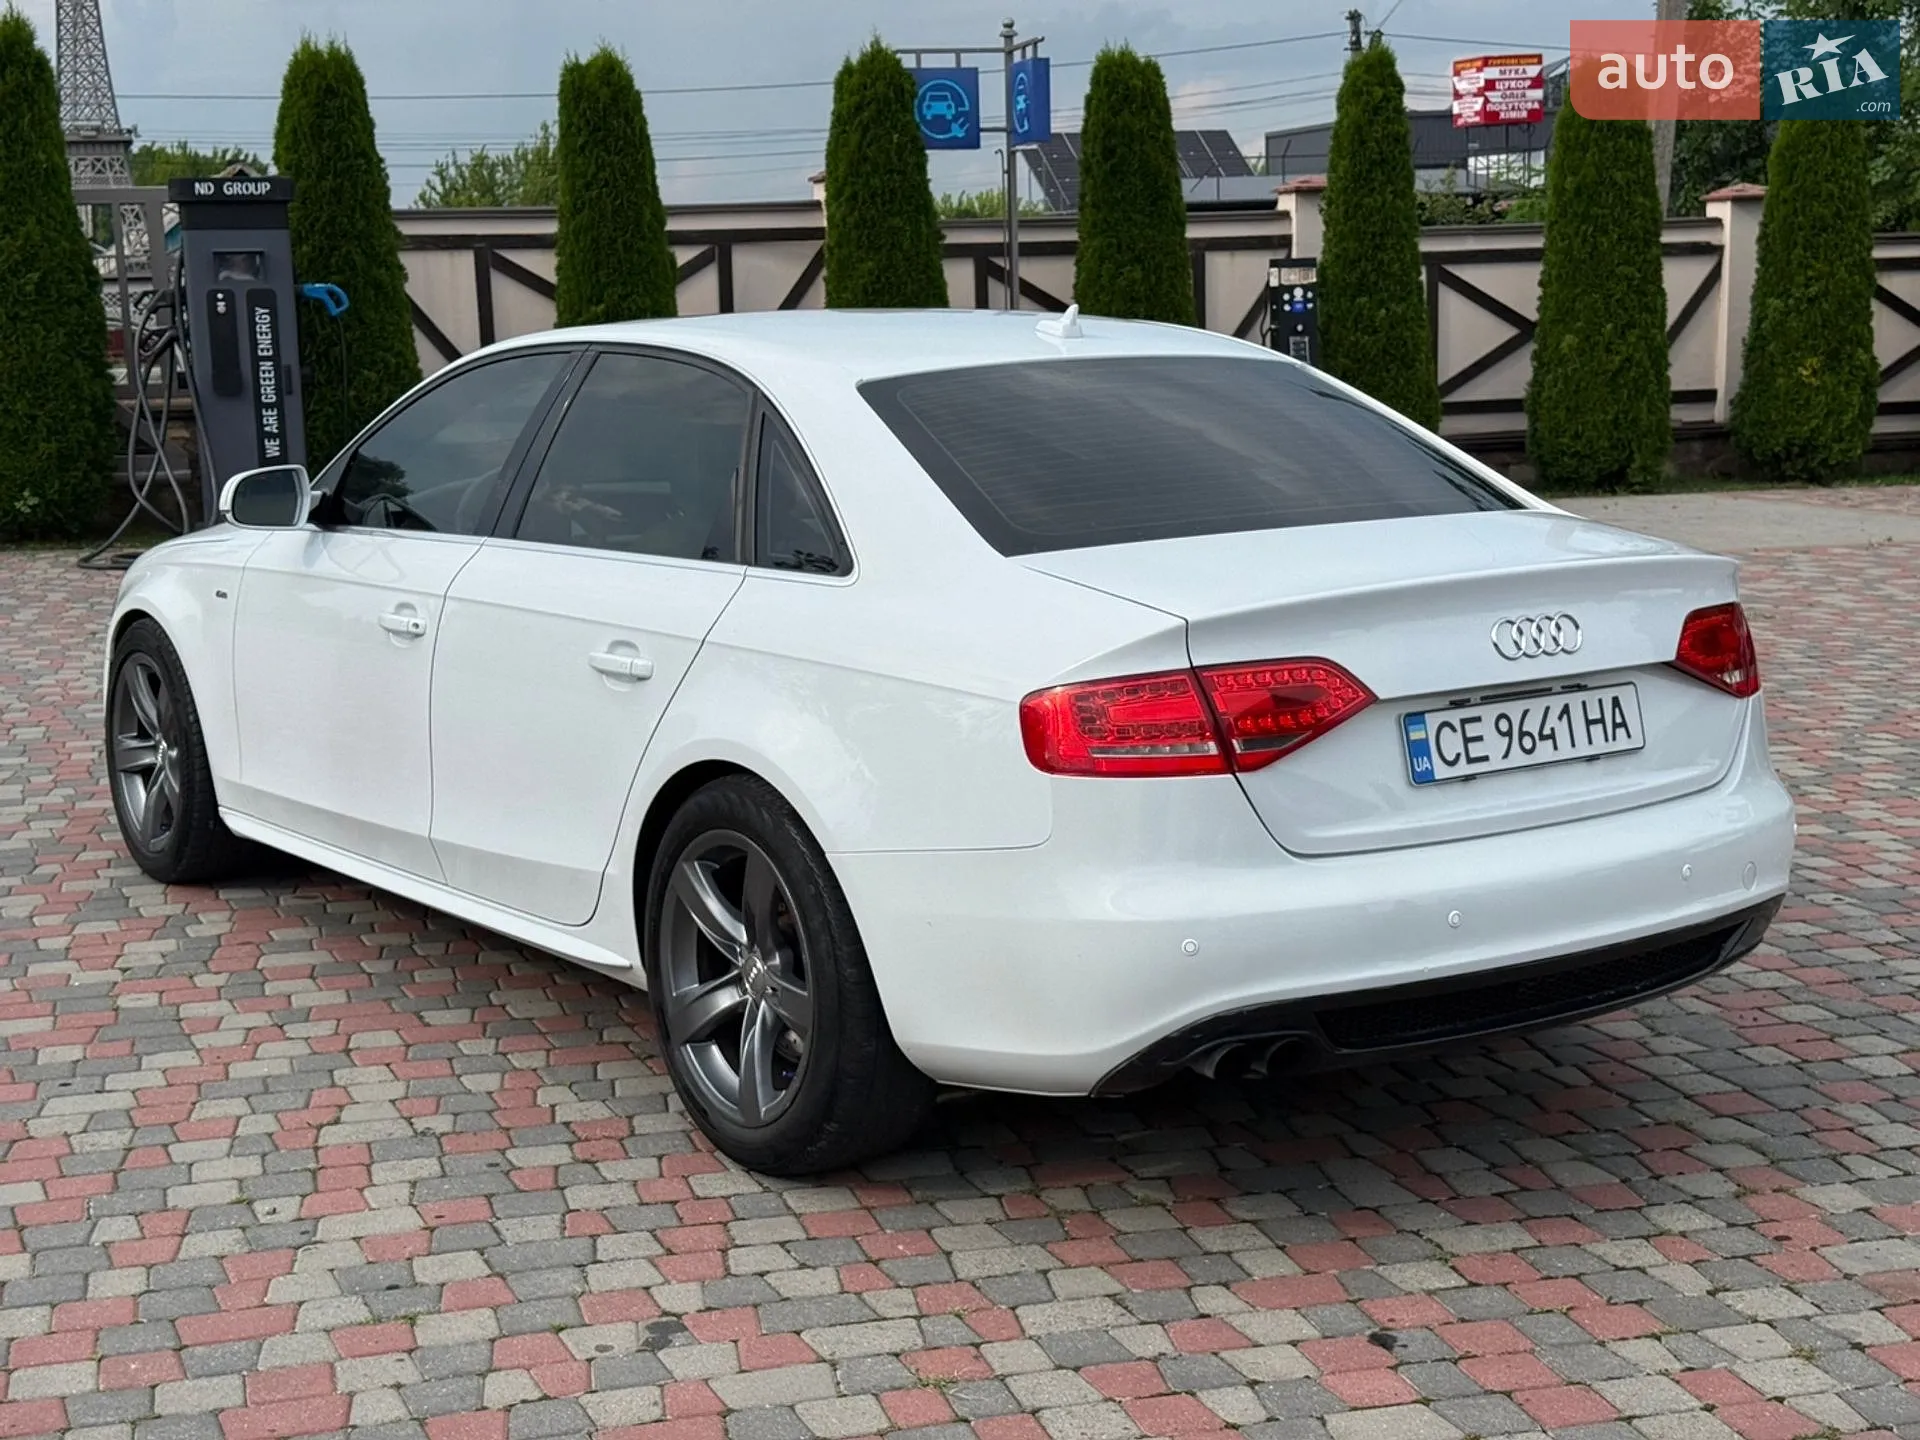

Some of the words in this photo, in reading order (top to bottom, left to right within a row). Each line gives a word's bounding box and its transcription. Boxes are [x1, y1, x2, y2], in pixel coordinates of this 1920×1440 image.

[1499, 67, 1527, 76] МУКА
[1495, 79, 1531, 90] ЦУКОР
[1500, 91, 1527, 100] ОЛІЯ
[1486, 101, 1540, 112] ПОБУТОВА
[1499, 110, 1528, 120] ХІМІЯ
[194, 181, 215, 196] ND
[223, 181, 271, 196] GROUP
[254, 306, 273, 358] ENERGY
[260, 361, 276, 404] GREEN
[263, 407, 280, 434] ARE
[265, 438, 281, 459] WE
[1435, 716, 1489, 767] CE
[1494, 702, 1575, 760] 9641
[1581, 695, 1632, 746] HA
[1414, 757, 1432, 772] UA
